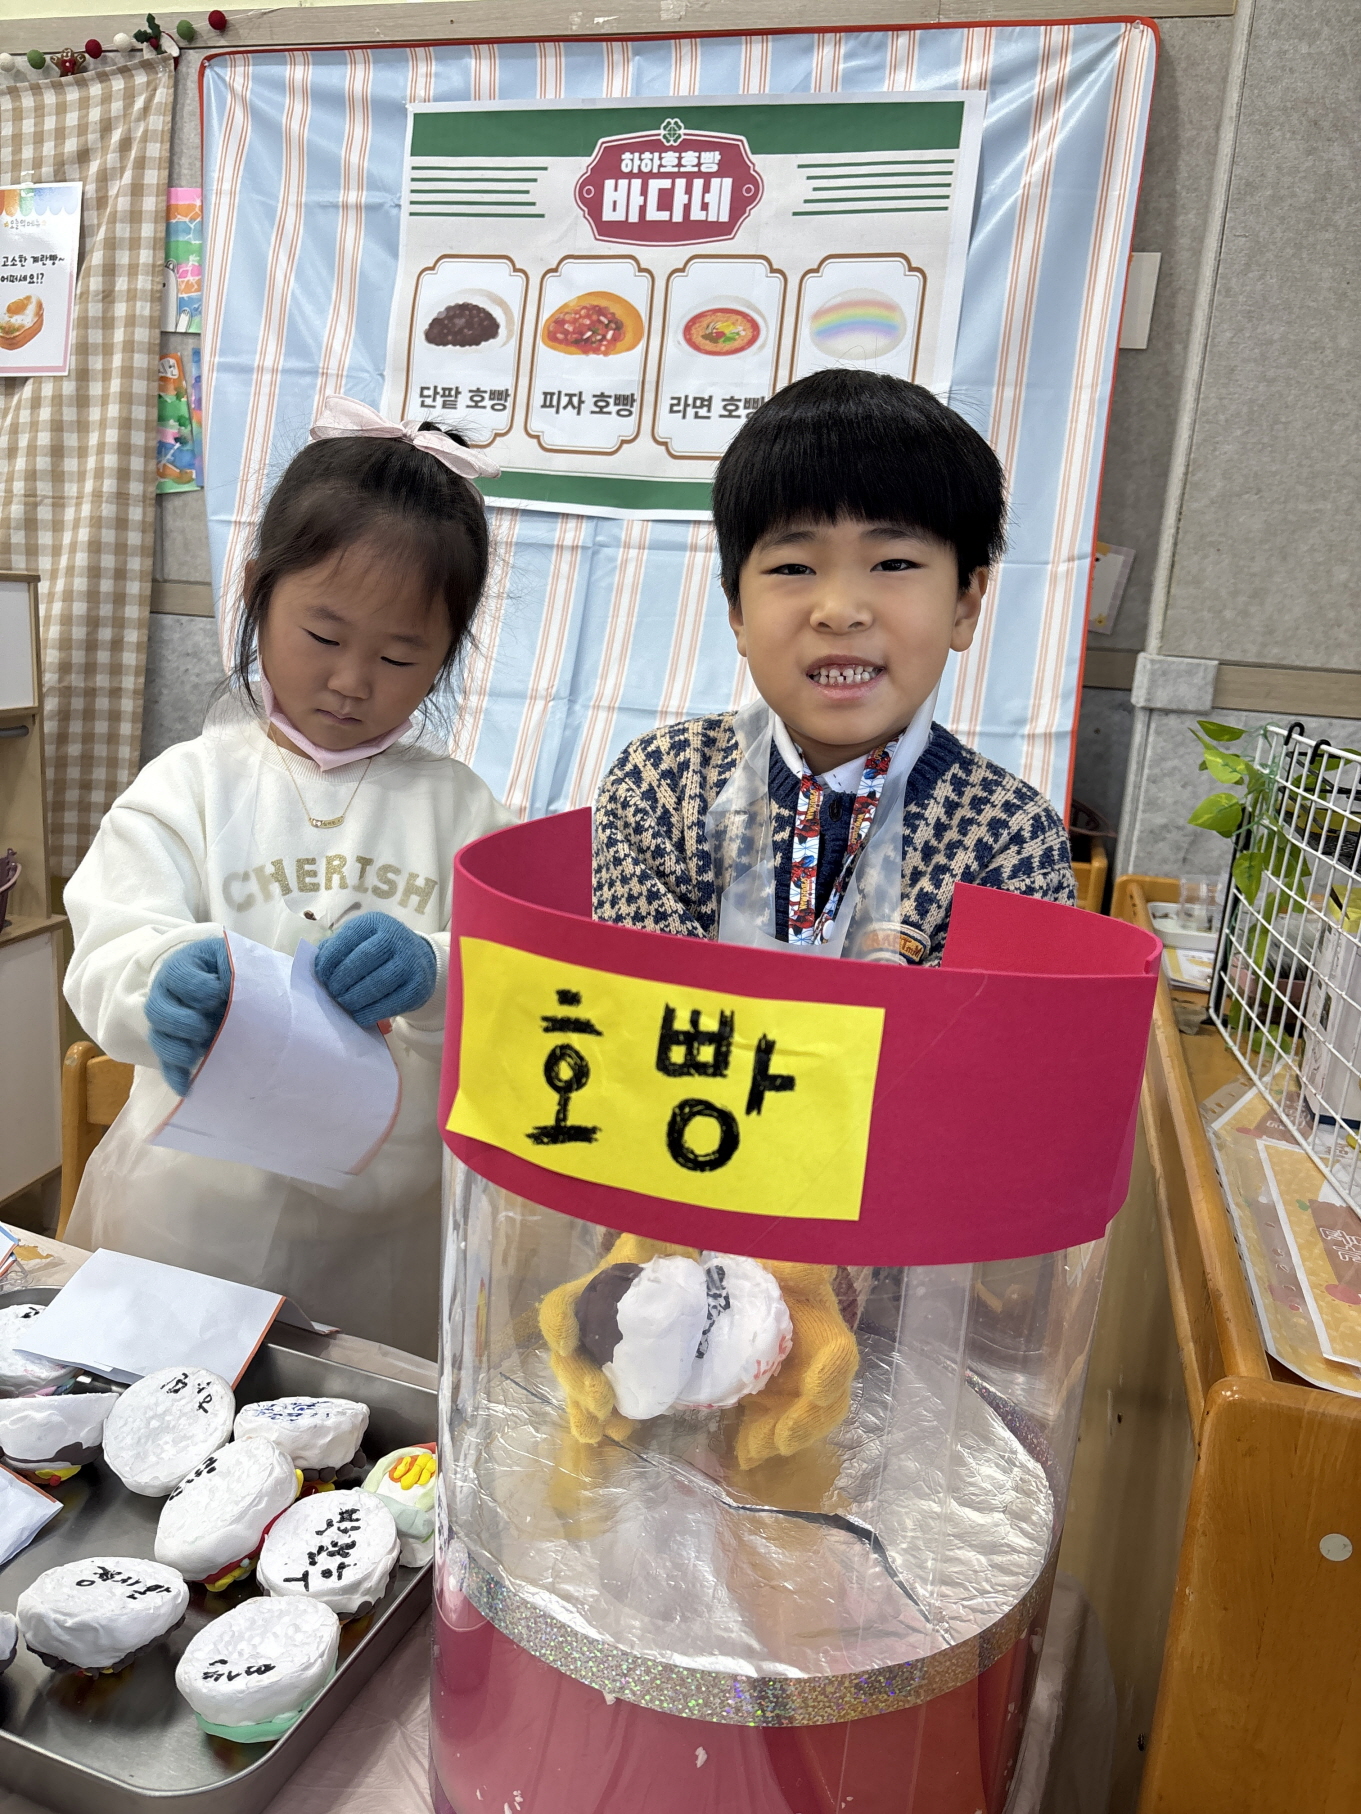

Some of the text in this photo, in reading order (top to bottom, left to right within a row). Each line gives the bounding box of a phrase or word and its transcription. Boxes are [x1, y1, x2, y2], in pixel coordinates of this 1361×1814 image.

[621, 151, 721, 173] 하하호호빵
[602, 178, 733, 222] 바다네
[1, 254, 28, 267] 고소한
[419, 385, 511, 412] 단팥 호빵
[540, 390, 637, 418] 피자 호빵
[668, 394, 714, 420] 라면
[222, 853, 438, 915] CHERISH
